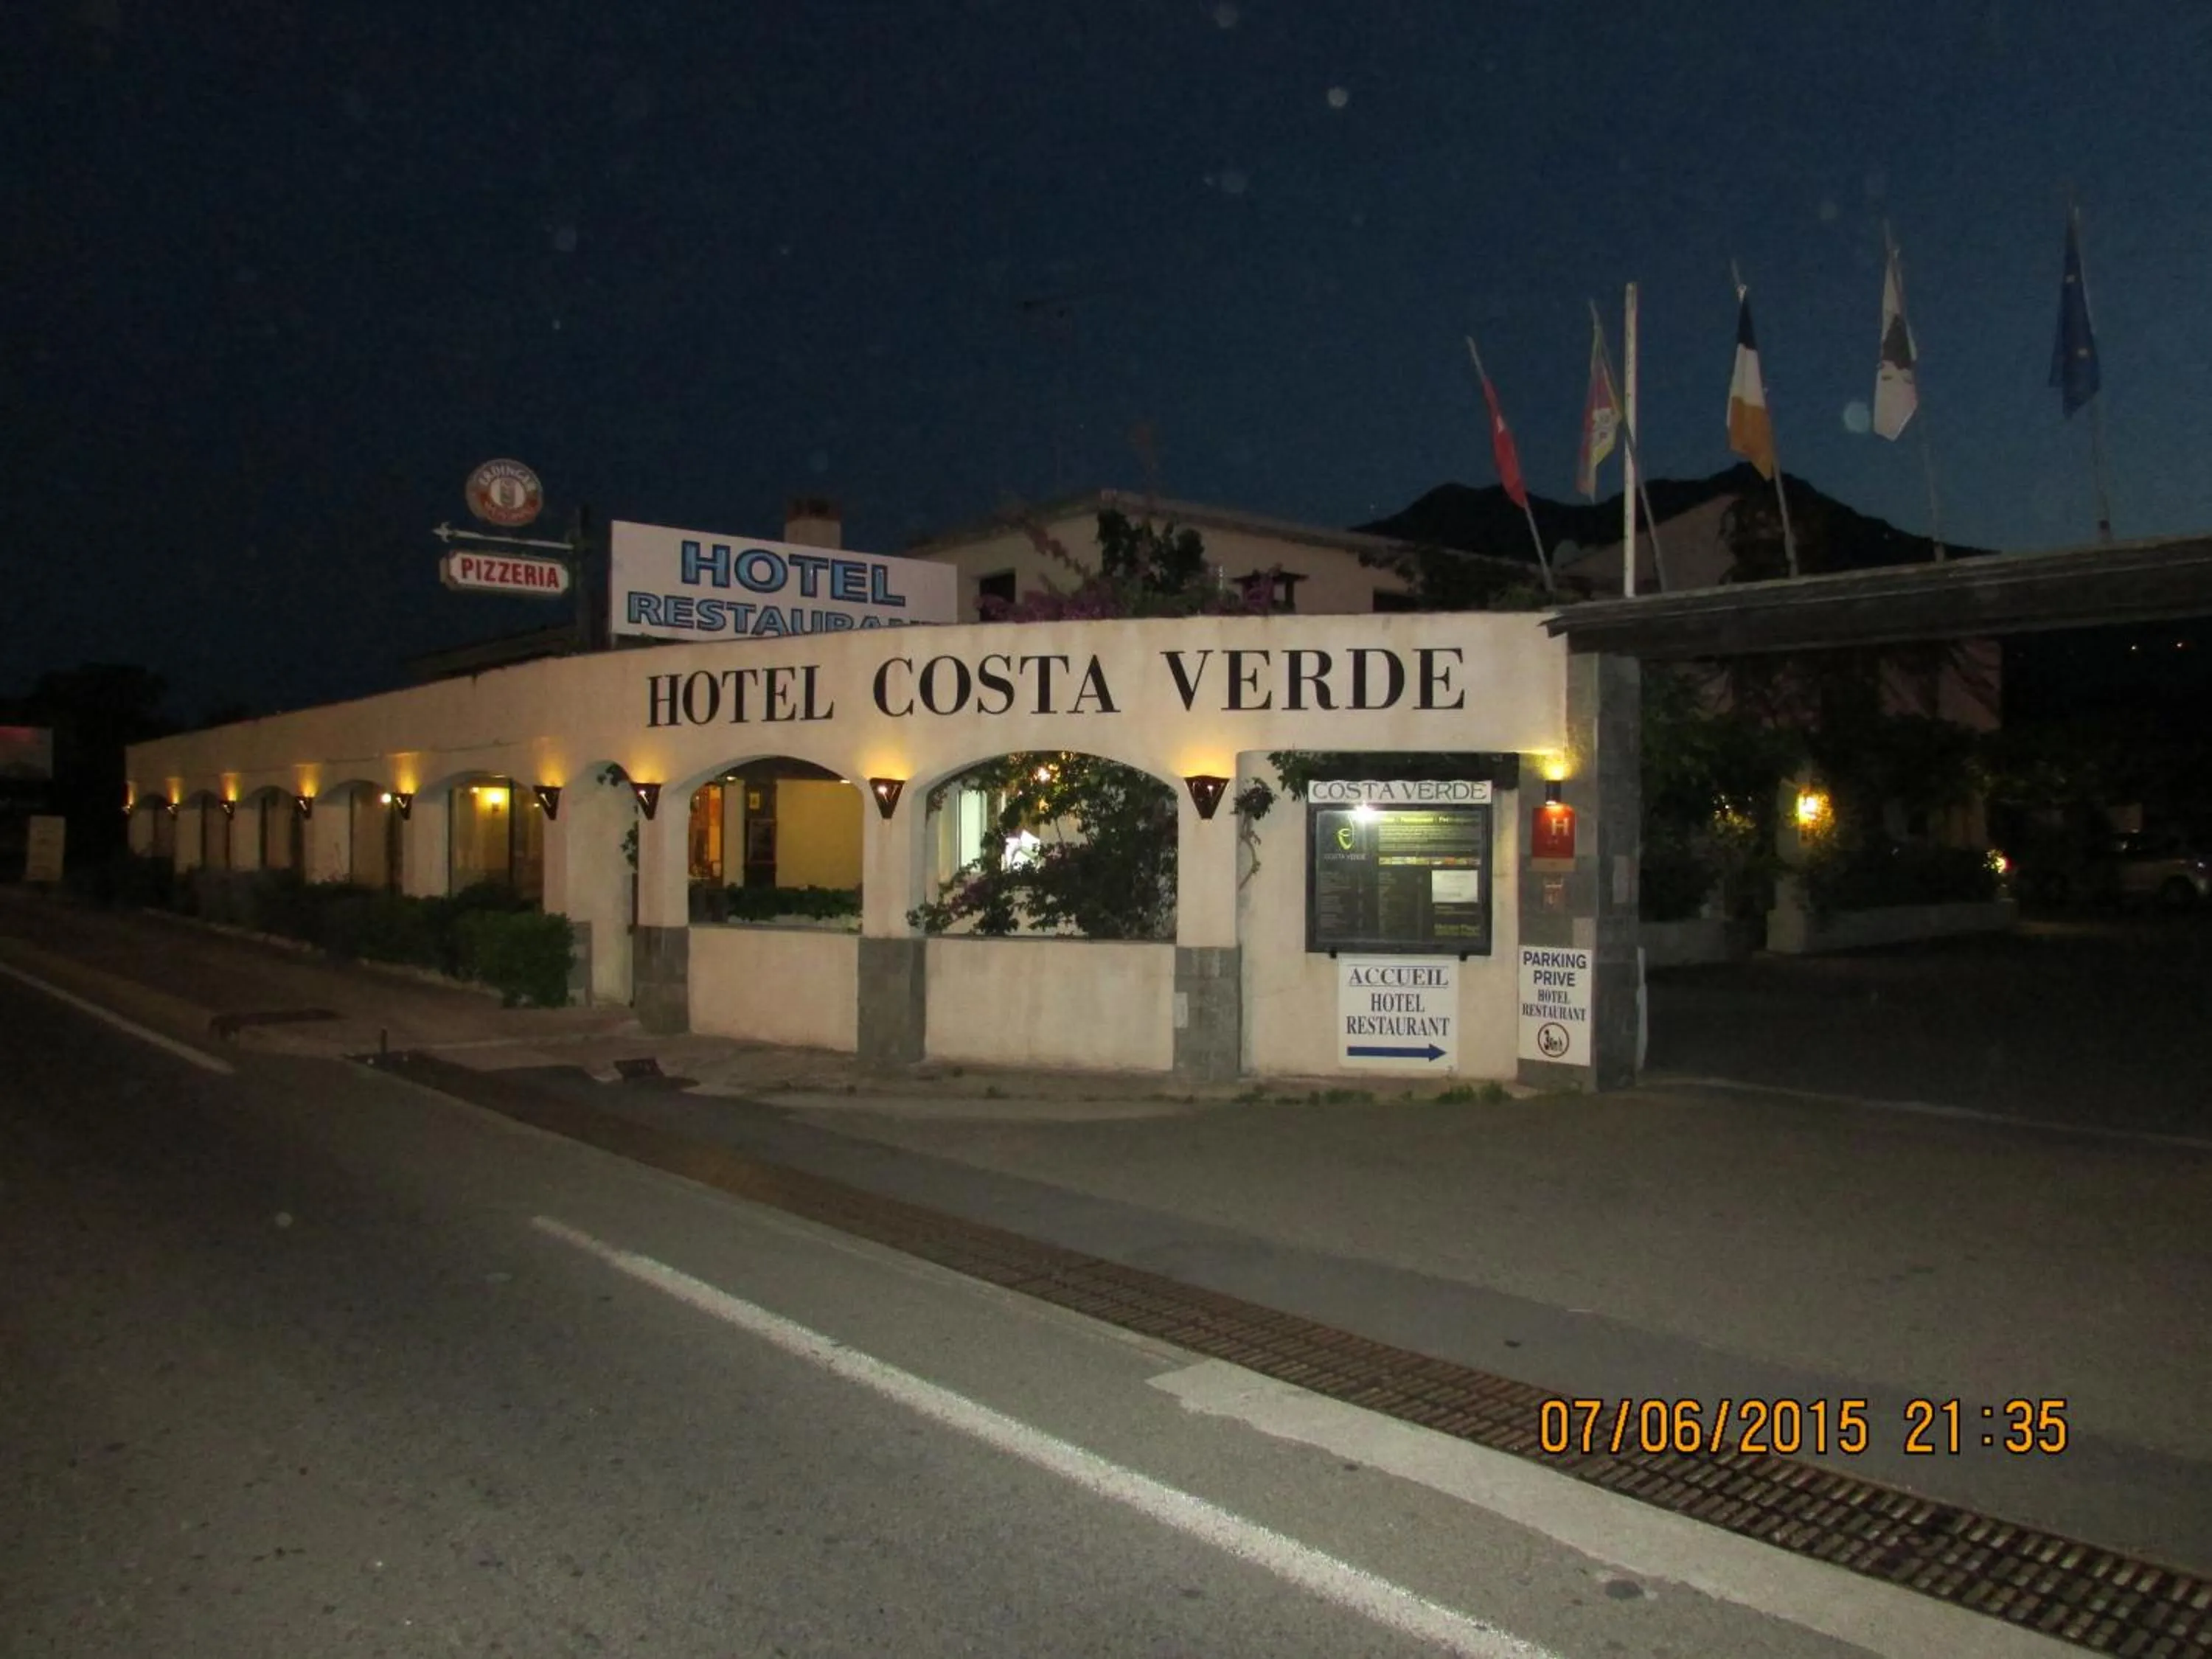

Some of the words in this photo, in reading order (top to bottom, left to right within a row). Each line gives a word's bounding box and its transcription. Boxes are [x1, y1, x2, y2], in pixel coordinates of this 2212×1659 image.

[461, 557, 560, 588] PIZZERIA
[681, 540, 905, 606] HOTEL
[646, 665, 835, 727] HOTEL
[872, 654, 1121, 717] COSTA
[1159, 647, 1465, 712] VERDE
[1312, 782, 1394, 800] COSTA
[1402, 782, 1487, 800] VERDE
[1523, 950, 1587, 969] PARKING
[1349, 967, 1448, 986] ACCUEIL
[1534, 970, 1576, 987] PRIVE
[1371, 992, 1425, 1012] HOTEL
[1537, 989, 1571, 1004] HOTEL
[1522, 1003, 1587, 1022] RESTAURANT
[1346, 1015, 1450, 1037] RESTAURANT
